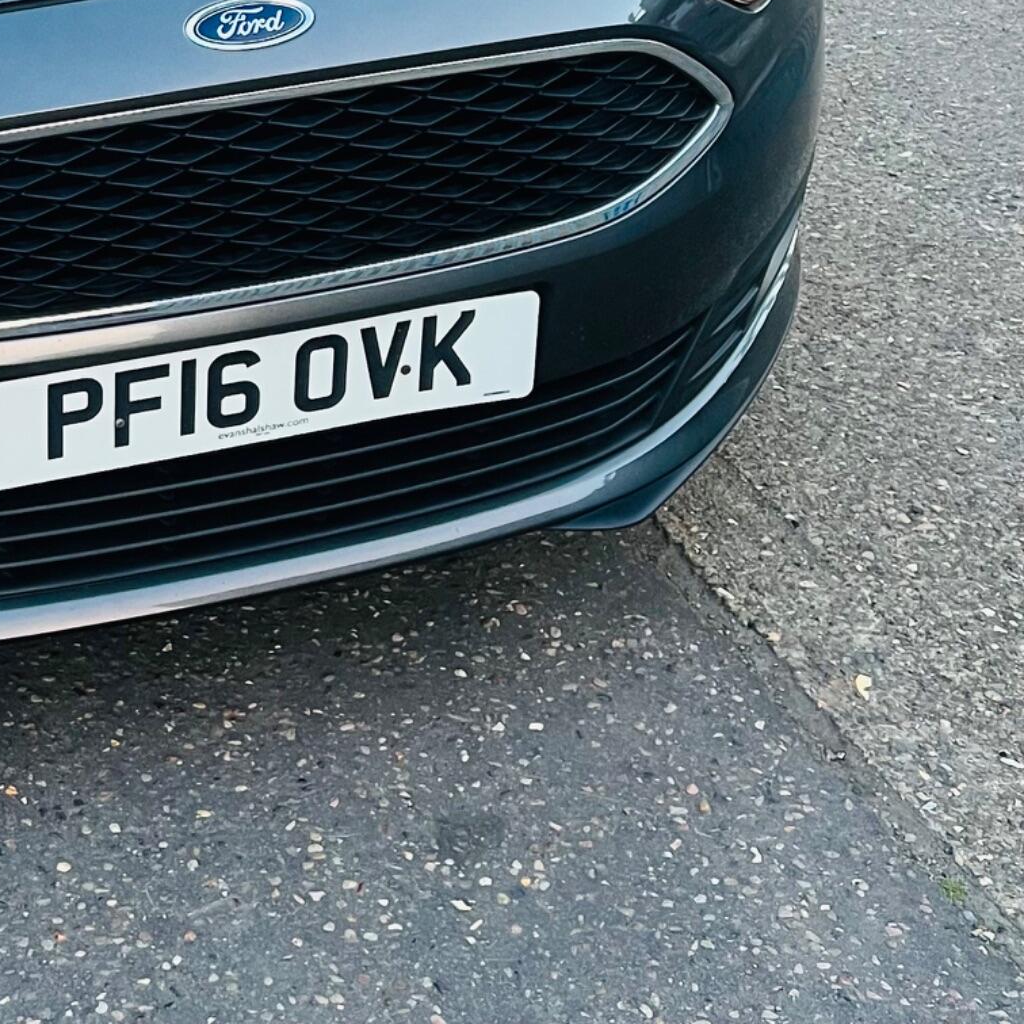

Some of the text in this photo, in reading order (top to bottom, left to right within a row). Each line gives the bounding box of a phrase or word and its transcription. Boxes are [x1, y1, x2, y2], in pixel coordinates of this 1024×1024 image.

[216, 6, 285, 40] Ford
[47, 309, 477, 461] PF16 OVK
[218, 417, 309, 440] evanshalshaw.com
